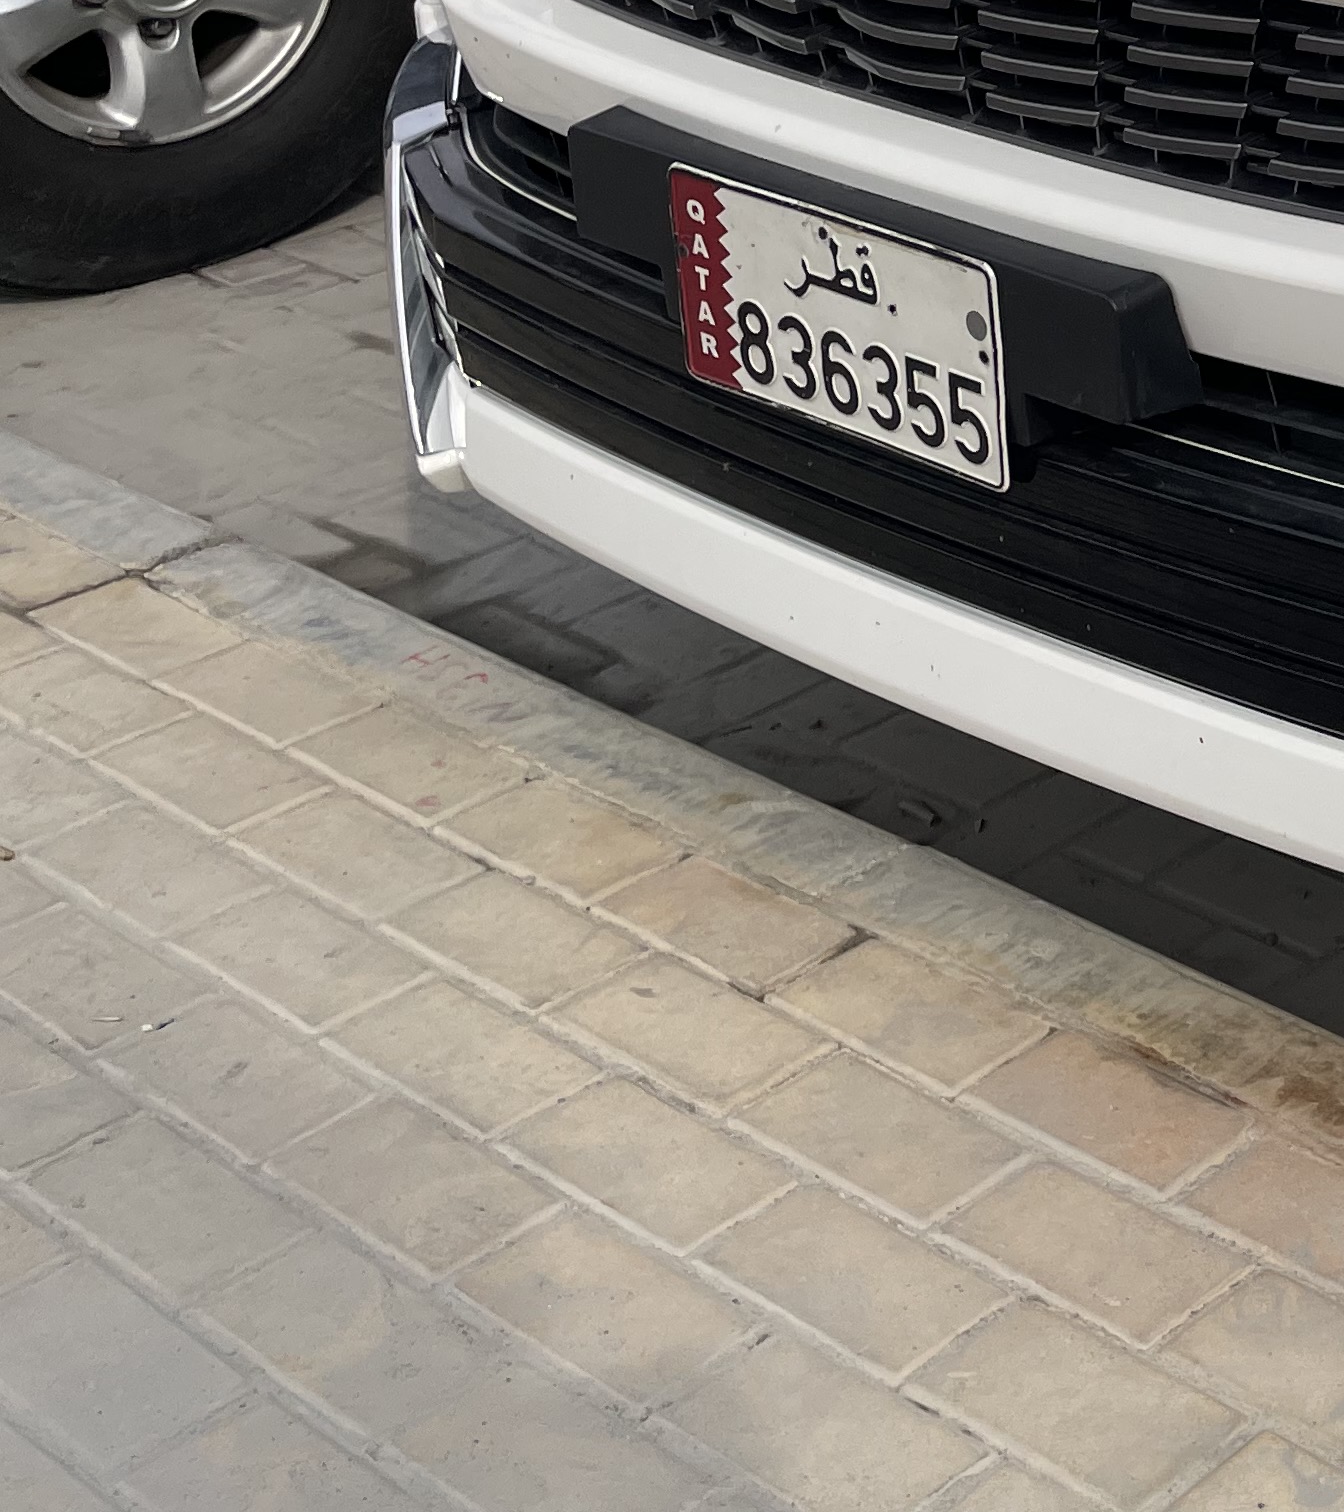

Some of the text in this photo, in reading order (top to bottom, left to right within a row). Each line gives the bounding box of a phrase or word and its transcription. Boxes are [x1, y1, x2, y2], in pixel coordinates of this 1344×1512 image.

[685, 198, 720, 361] QATAR
[783, 236, 881, 306] قطر
[737, 299, 993, 467] 836355
